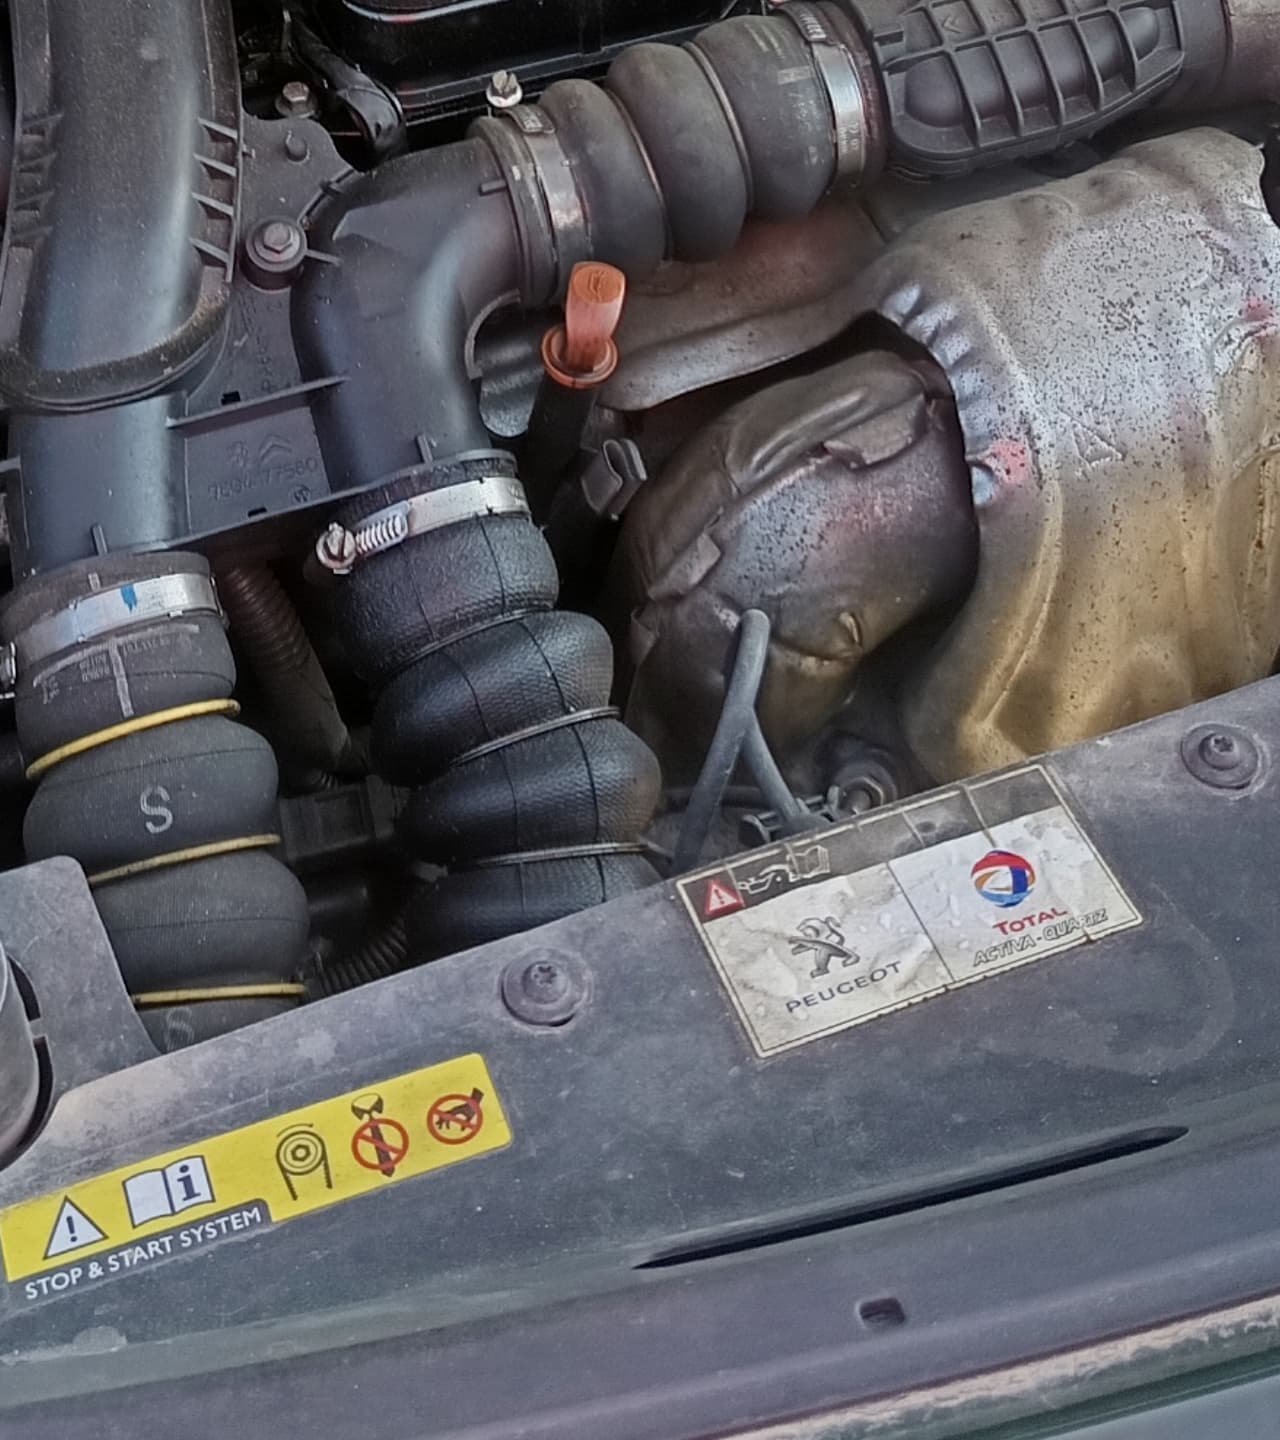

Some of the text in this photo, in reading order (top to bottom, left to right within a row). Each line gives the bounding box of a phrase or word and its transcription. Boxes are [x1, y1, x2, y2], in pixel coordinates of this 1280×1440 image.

[138, 786, 174, 834] S
[993, 907, 1068, 935] TOTAL
[785, 959, 903, 1014] PEUGEOT
[25, 1207, 262, 1300] STOP & START SYSTEM
